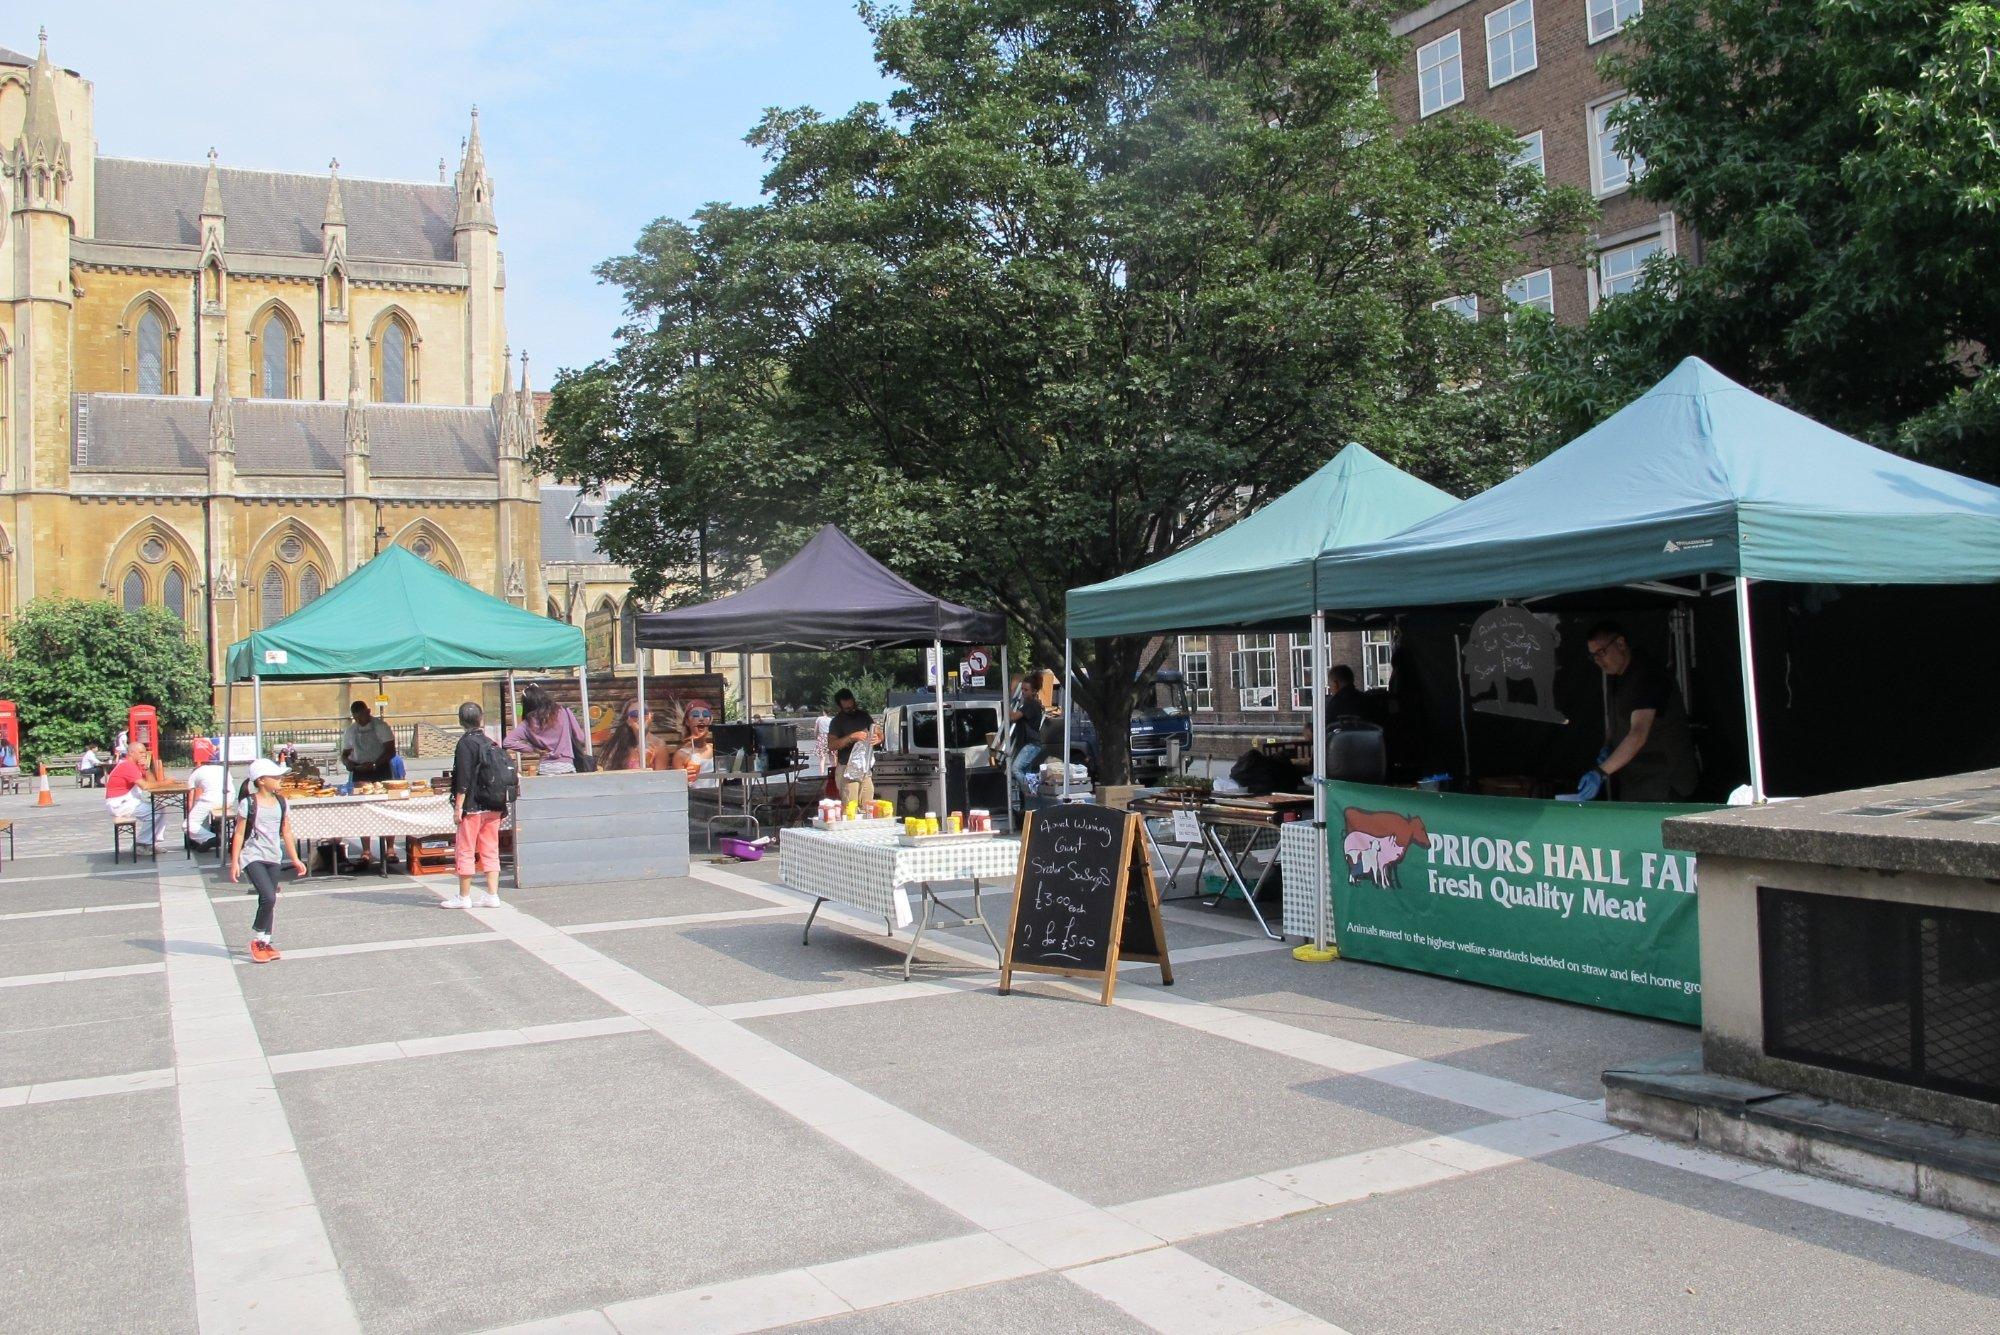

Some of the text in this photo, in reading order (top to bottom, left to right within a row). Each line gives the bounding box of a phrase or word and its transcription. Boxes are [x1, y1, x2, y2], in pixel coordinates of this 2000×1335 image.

[1427, 832, 1534, 874] PRIORS
[1542, 843, 1629, 886] HALL
[1427, 869, 1647, 923] Fresh Quality Meat
[1023, 924, 1032, 947] 2
[1041, 920, 1057, 946] for
[1346, 922, 1378, 936] Animals
[1378, 929, 1402, 941] reared
[1404, 932, 1412, 942] to
[1413, 932, 1426, 945] the
[1426, 934, 1456, 950] highest
[1456, 942, 1487, 955] welfare
[1488, 947, 1529, 963] standards
[1529, 952, 1565, 970] bedded
[1567, 961, 1580, 972] on
[1581, 964, 1608, 977] straw
[1610, 969, 1628, 981] and
[1630, 969, 1647, 984] fed
[1649, 973, 1682, 989] home
